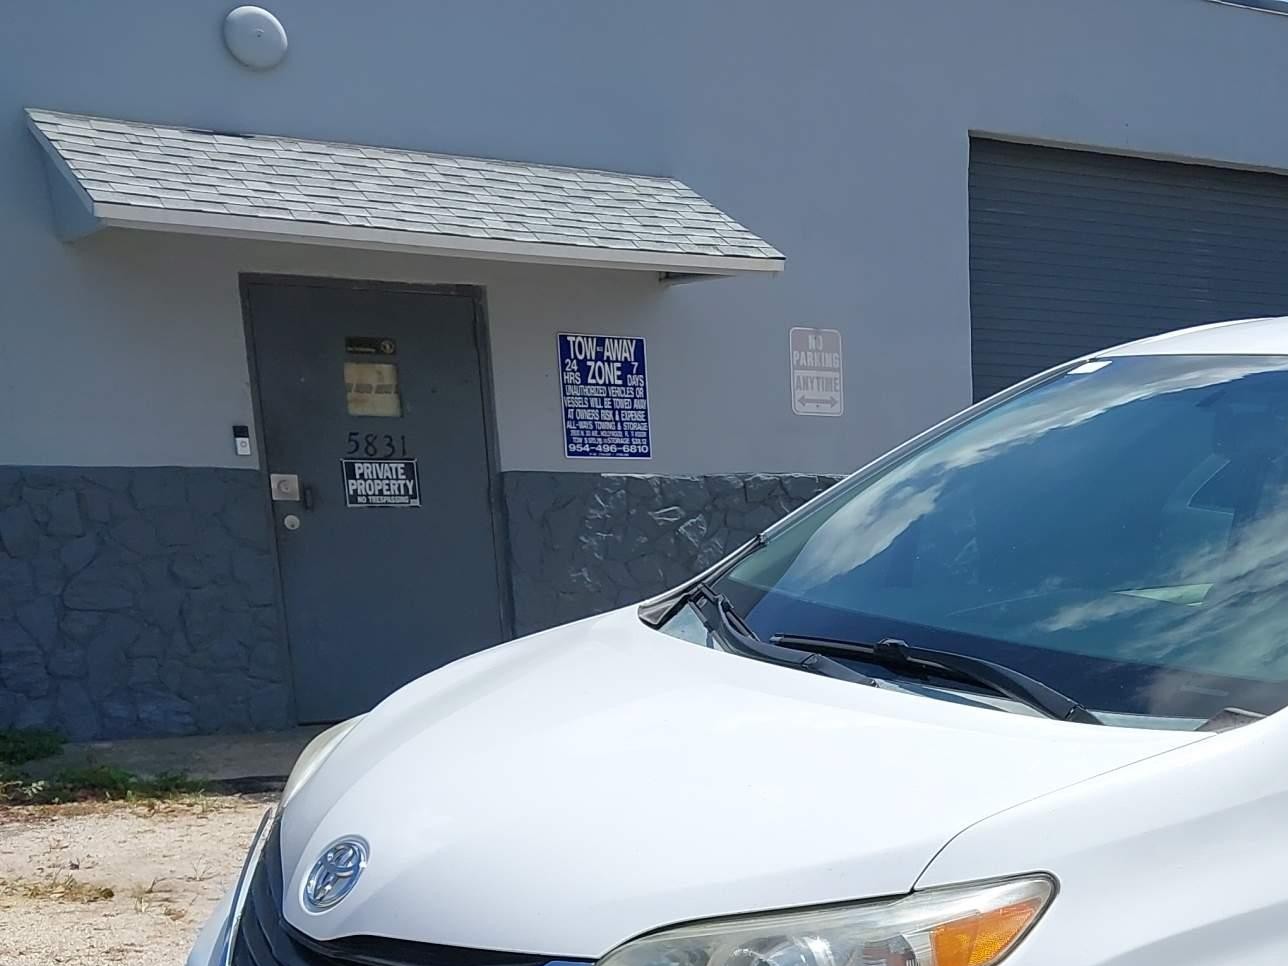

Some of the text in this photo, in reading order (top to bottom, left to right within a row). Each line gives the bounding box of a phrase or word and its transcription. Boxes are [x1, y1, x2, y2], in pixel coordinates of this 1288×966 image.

[566, 336, 636, 361] TOW-AWAY
[808, 335, 823, 350] NO
[564, 359, 578, 371] 24
[793, 351, 840, 368] PARKING
[586, 360, 623, 385] ZONE
[631, 362, 639, 374] 7
[563, 372, 581, 385] HRS
[626, 374, 645, 387] DAYS
[794, 375, 840, 392] ANYTIME
[565, 384, 644, 398] UNAUTHORIZED VEHICLES OR
[563, 396, 589, 408] VESSELS
[589, 397, 603, 408] WILL
[604, 397, 612, 408] BE
[613, 398, 632, 409] TOWED
[567, 408, 574, 420] AT
[600, 409, 614, 420] RISK
[620, 410, 646, 421] EXPENSE
[594, 421, 616, 430] TOWING
[623, 422, 648, 431] STORAGE
[346, 431, 408, 457] 5831
[568, 443, 649, 453] 954-496-6810
[354, 463, 406, 479] PRIVATE
[348, 479, 414, 495] PROPERTY
[357, 495, 367, 503] NO
